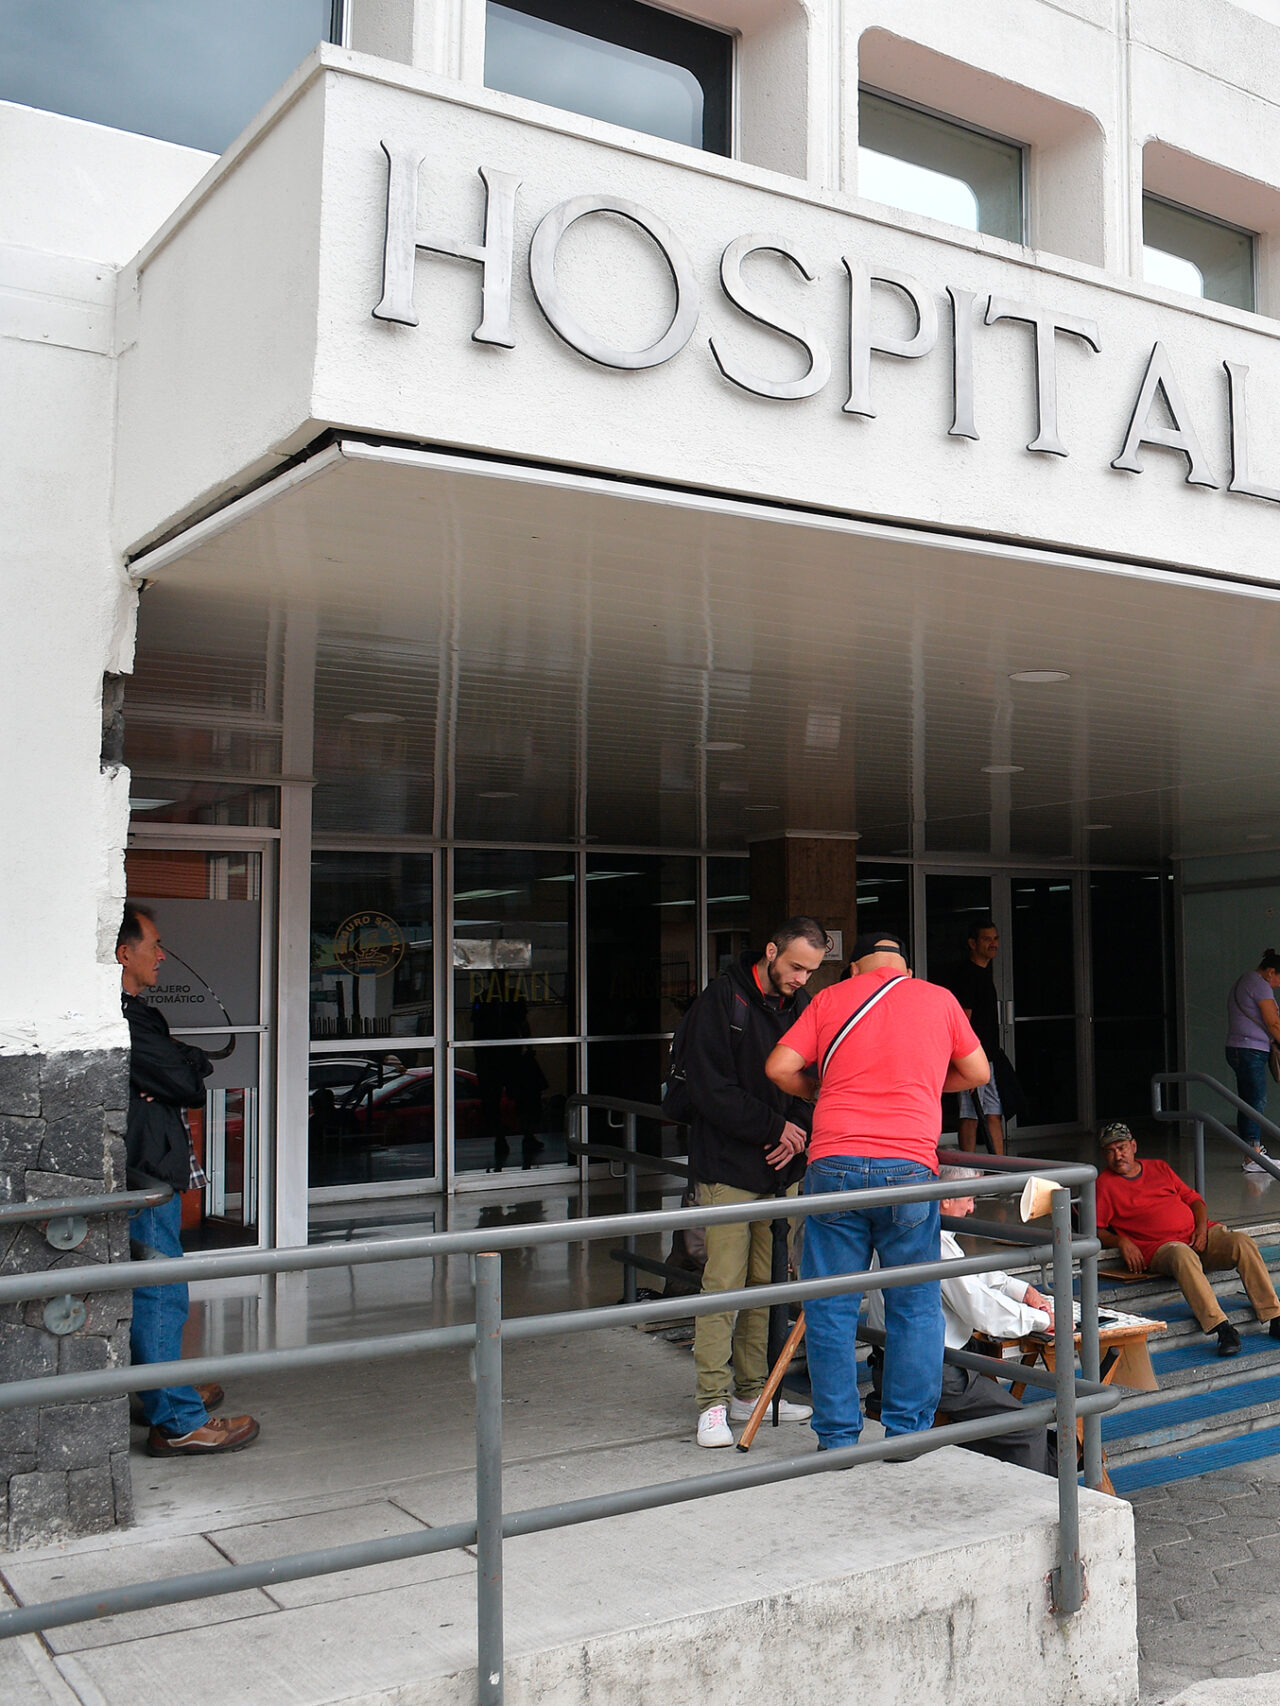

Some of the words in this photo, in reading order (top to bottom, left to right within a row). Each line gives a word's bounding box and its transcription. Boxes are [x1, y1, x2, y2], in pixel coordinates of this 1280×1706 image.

[149, 984, 191, 993] CAJERO
[468, 969, 556, 1003] RAFAEL
[146, 993, 205, 1004] TOMÁTICO
